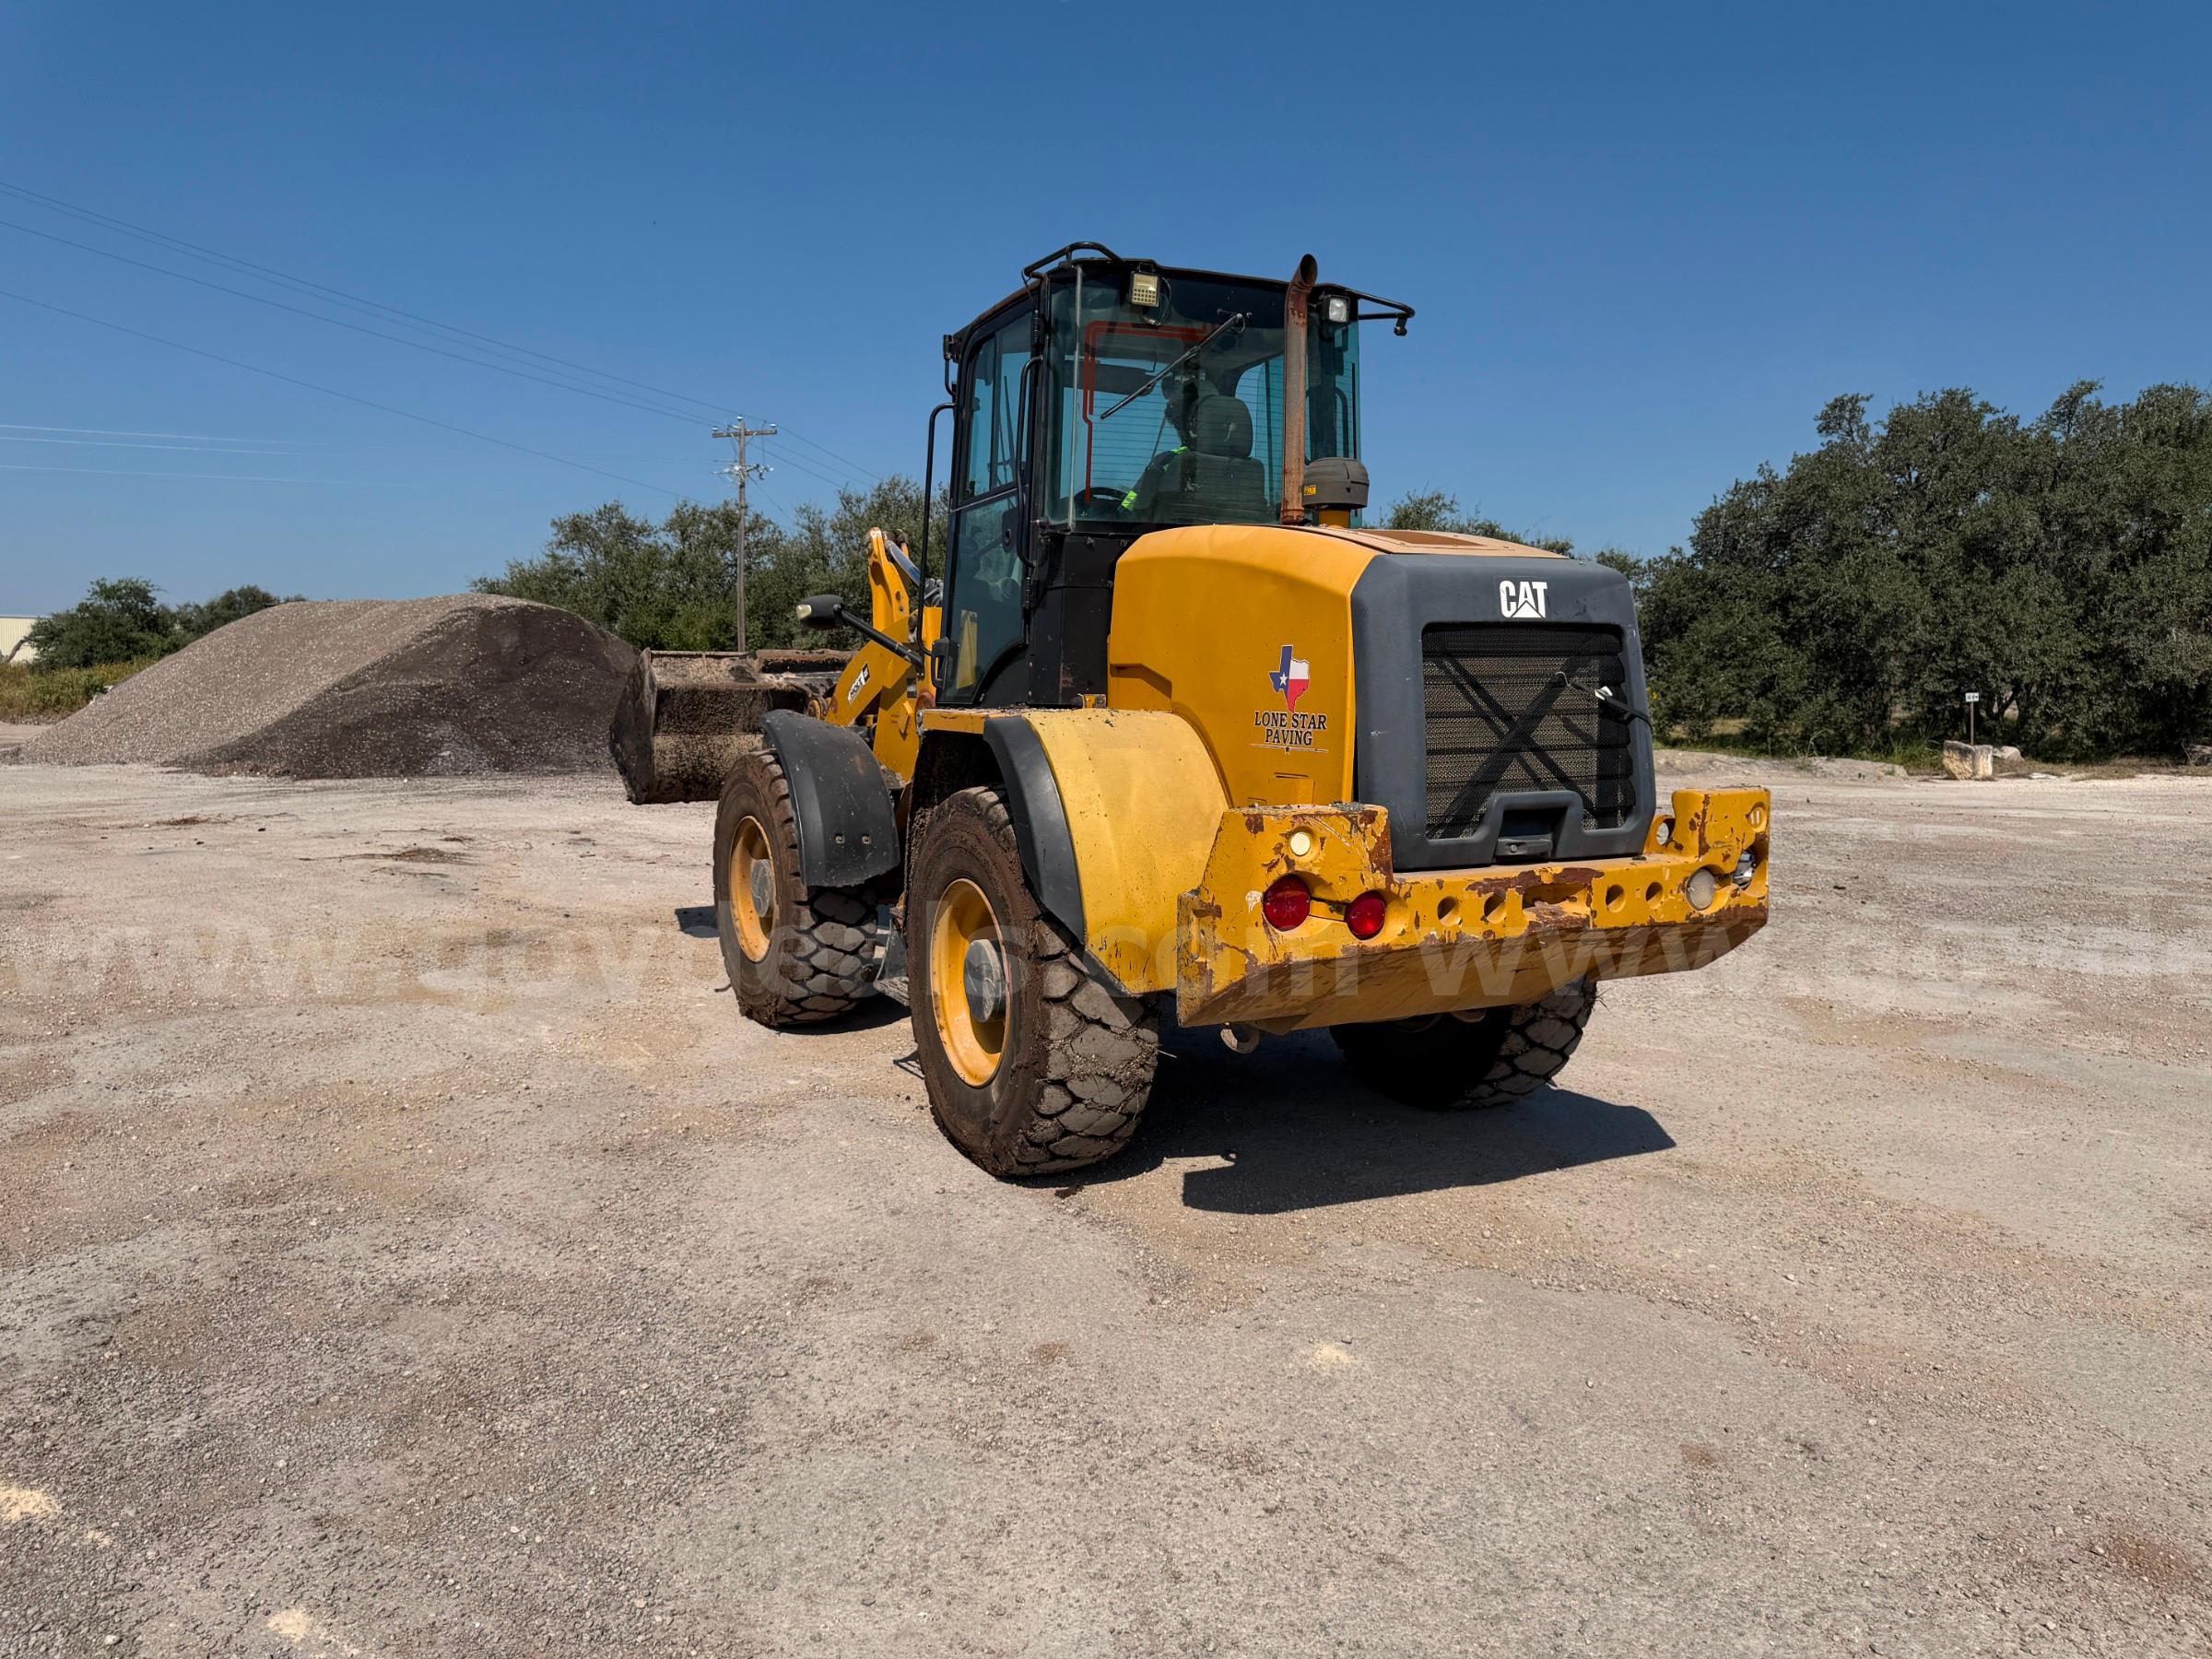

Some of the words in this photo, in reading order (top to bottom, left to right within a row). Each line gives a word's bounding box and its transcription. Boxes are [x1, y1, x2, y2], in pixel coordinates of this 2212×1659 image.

[1500, 580, 1547, 618] CAT
[1253, 711, 1288, 728] LONE
[1291, 712, 1327, 730] STAR
[1265, 728, 1313, 746] PAVING
